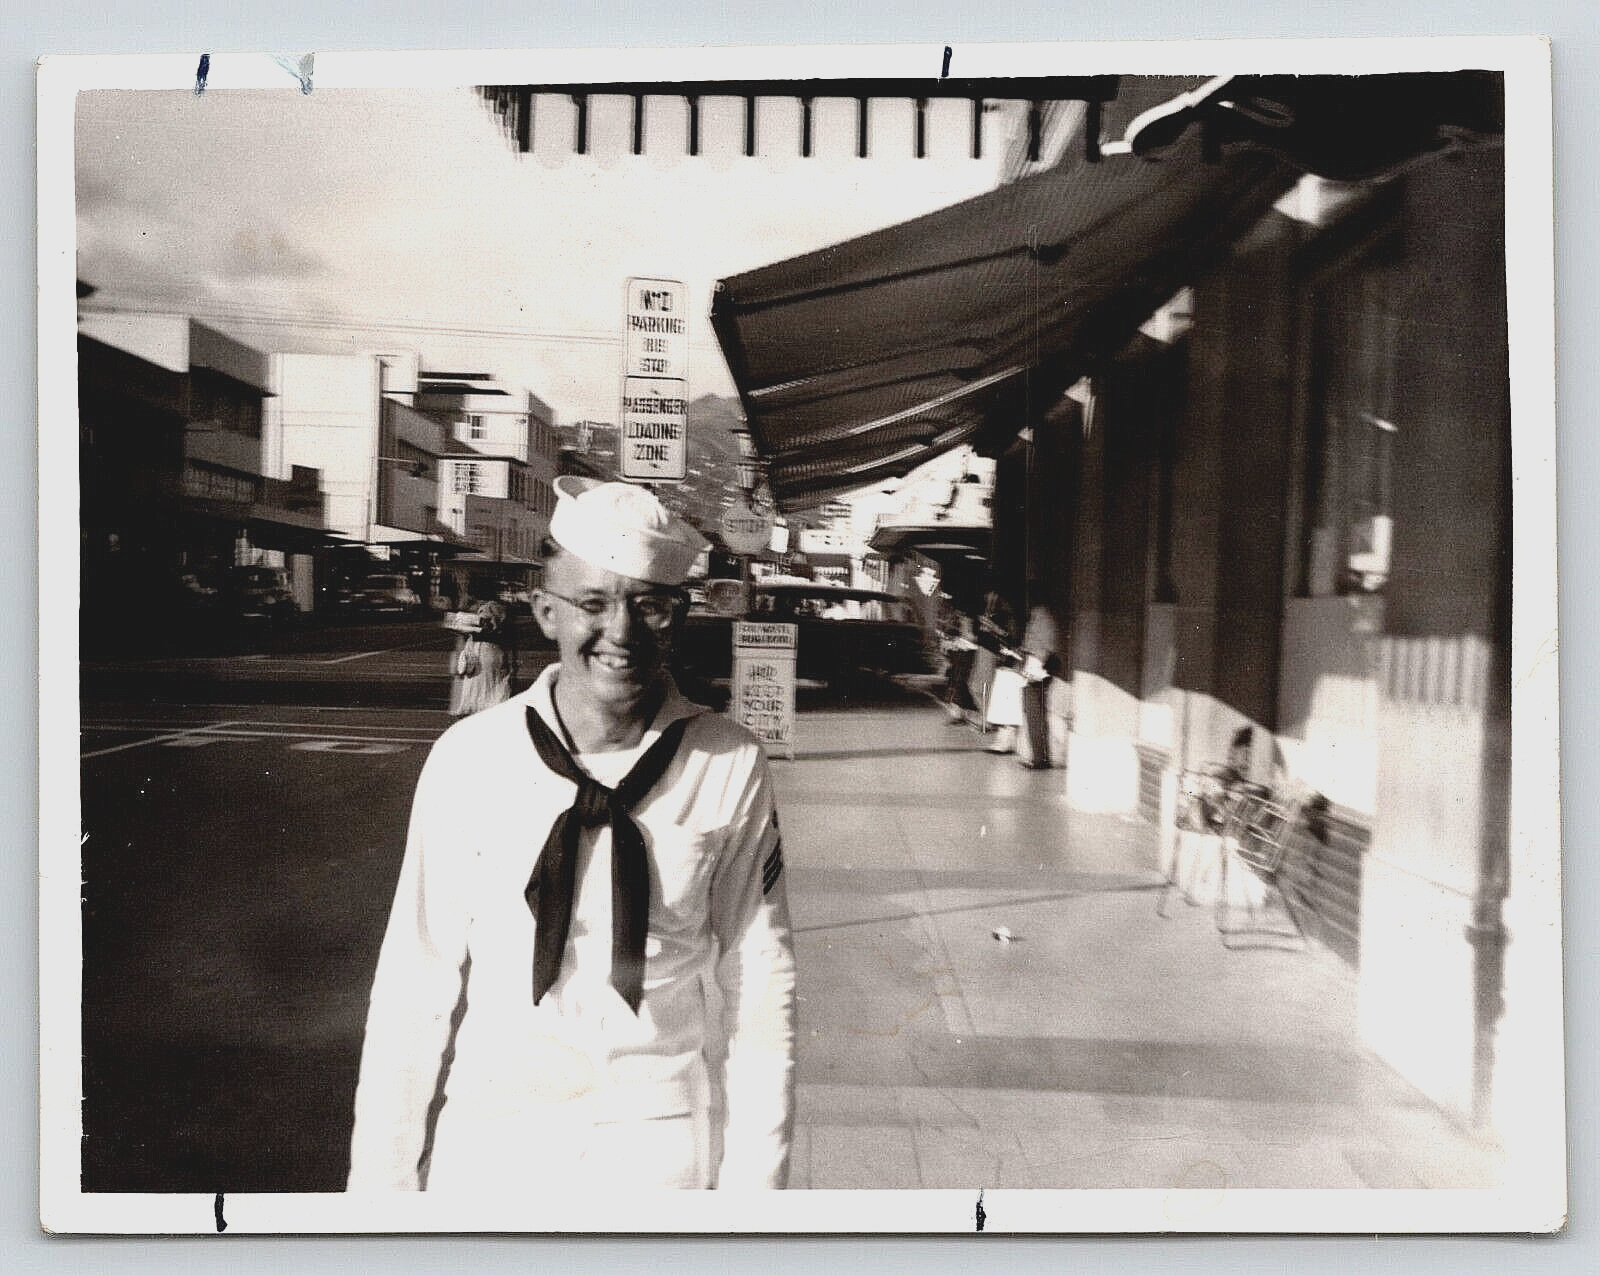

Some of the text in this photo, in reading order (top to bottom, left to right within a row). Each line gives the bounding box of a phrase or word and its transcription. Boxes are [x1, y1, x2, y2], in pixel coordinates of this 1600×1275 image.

[640, 289, 672, 311] NO
[630, 317, 685, 334] PARKING
[642, 338, 668, 353] BUS
[639, 358, 670, 374] STOP
[623, 397, 685, 416] PASSENGER
[626, 422, 682, 441] LOADING
[633, 444, 669, 461] ZONE
[725, 518, 770, 534] STOP
[742, 699, 784, 712] YOUR
[742, 713, 784, 726] CITY
